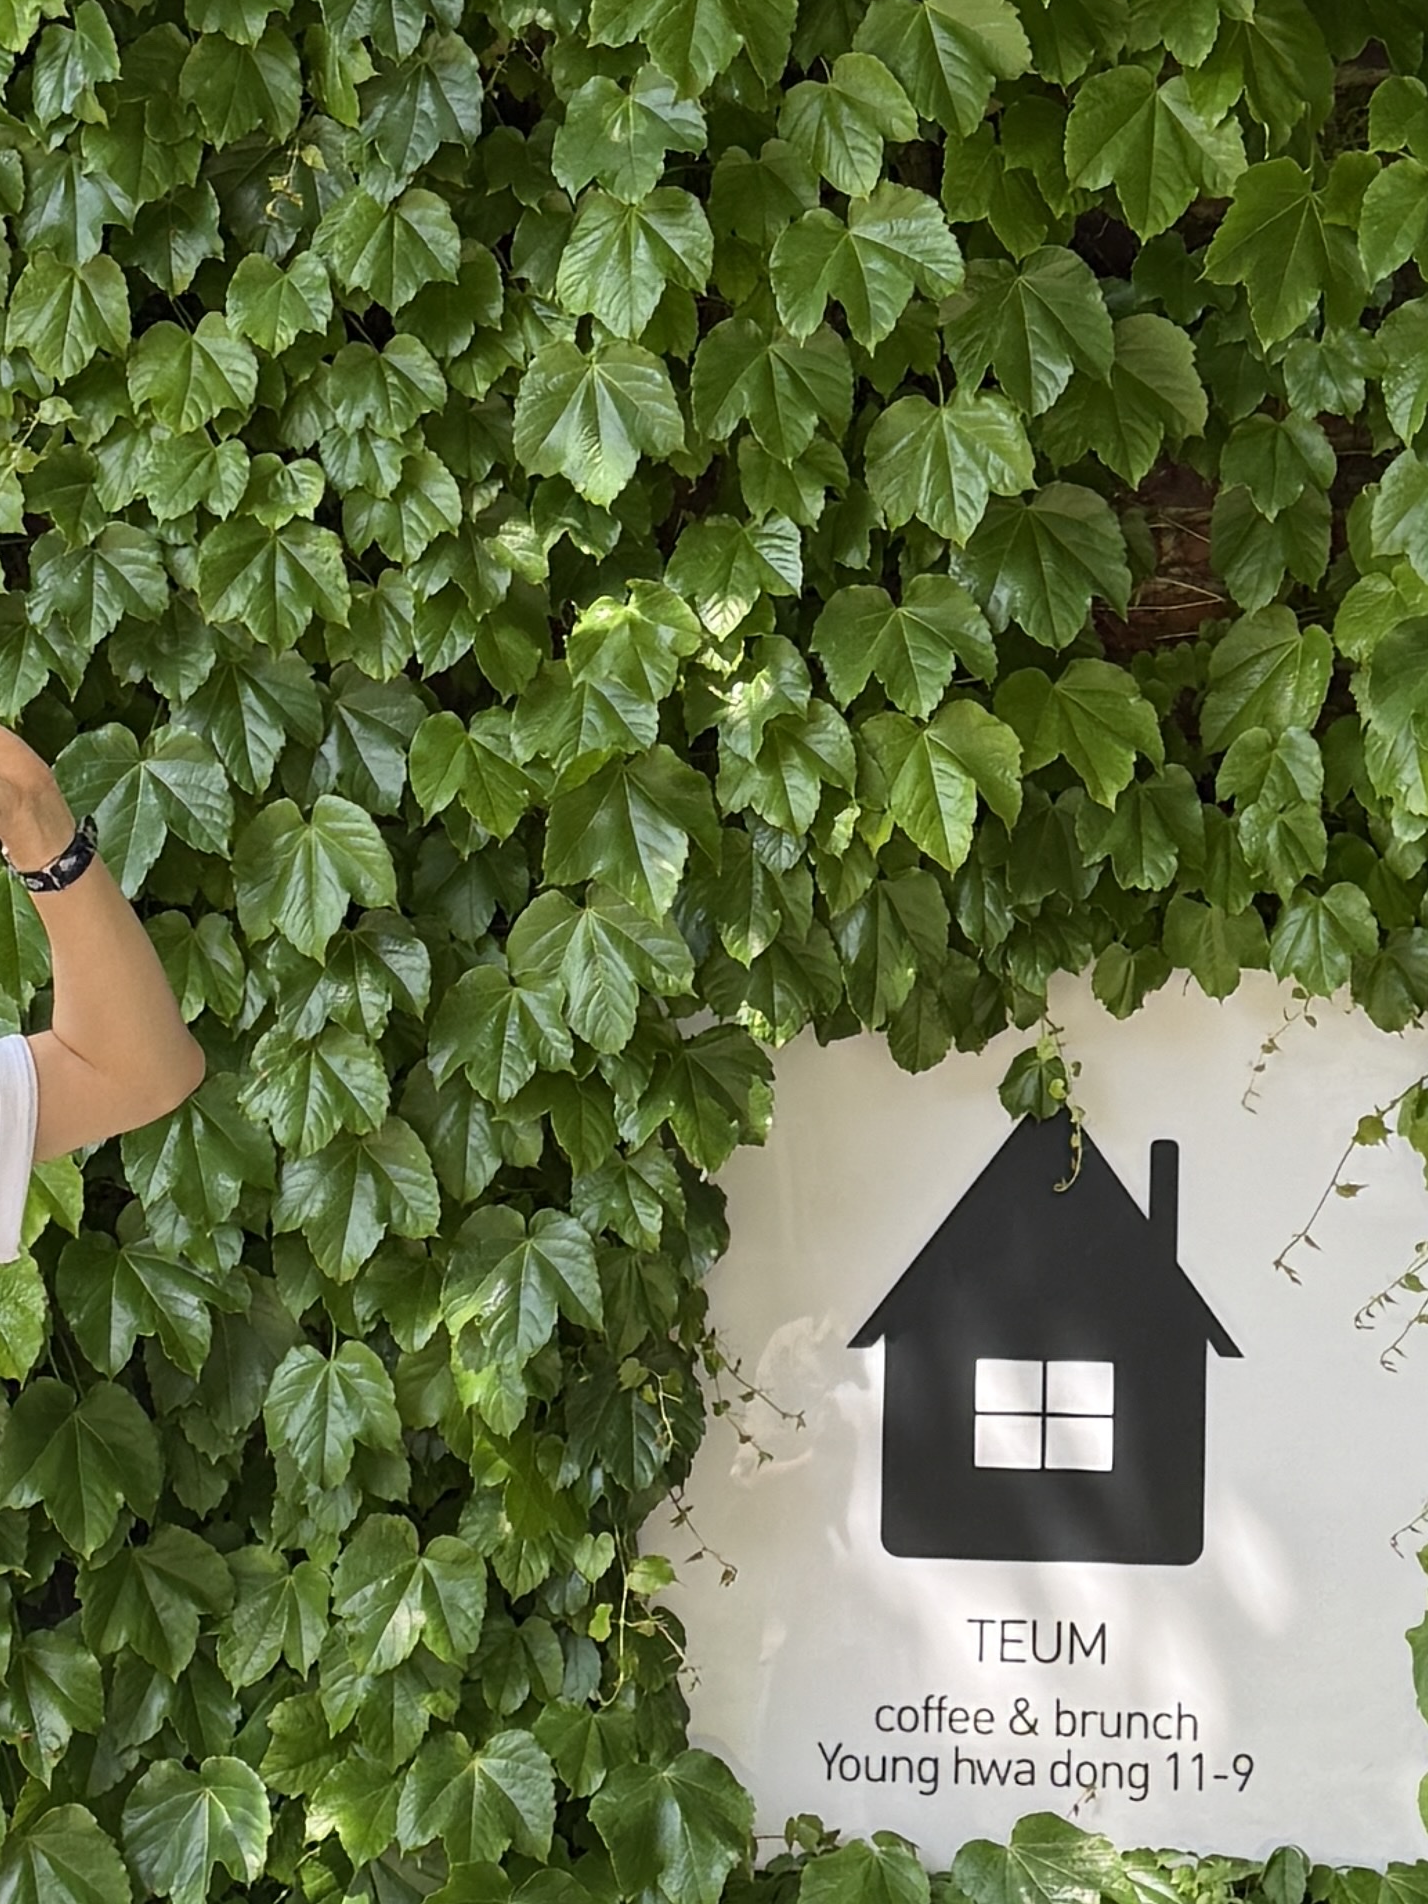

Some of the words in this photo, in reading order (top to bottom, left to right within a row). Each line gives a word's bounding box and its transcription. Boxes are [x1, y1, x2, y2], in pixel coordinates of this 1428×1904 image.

[967, 1619, 1107, 1665] TEUM
[875, 1694, 995, 1736] coffee
[1009, 1697, 1039, 1737] &
[1055, 1698, 1199, 1741] brunch
[817, 1741, 939, 1796] Young
[953, 1746, 1036, 1786] hwa
[1049, 1748, 1150, 1802] dong
[1166, 1752, 1254, 1792] 11-9
